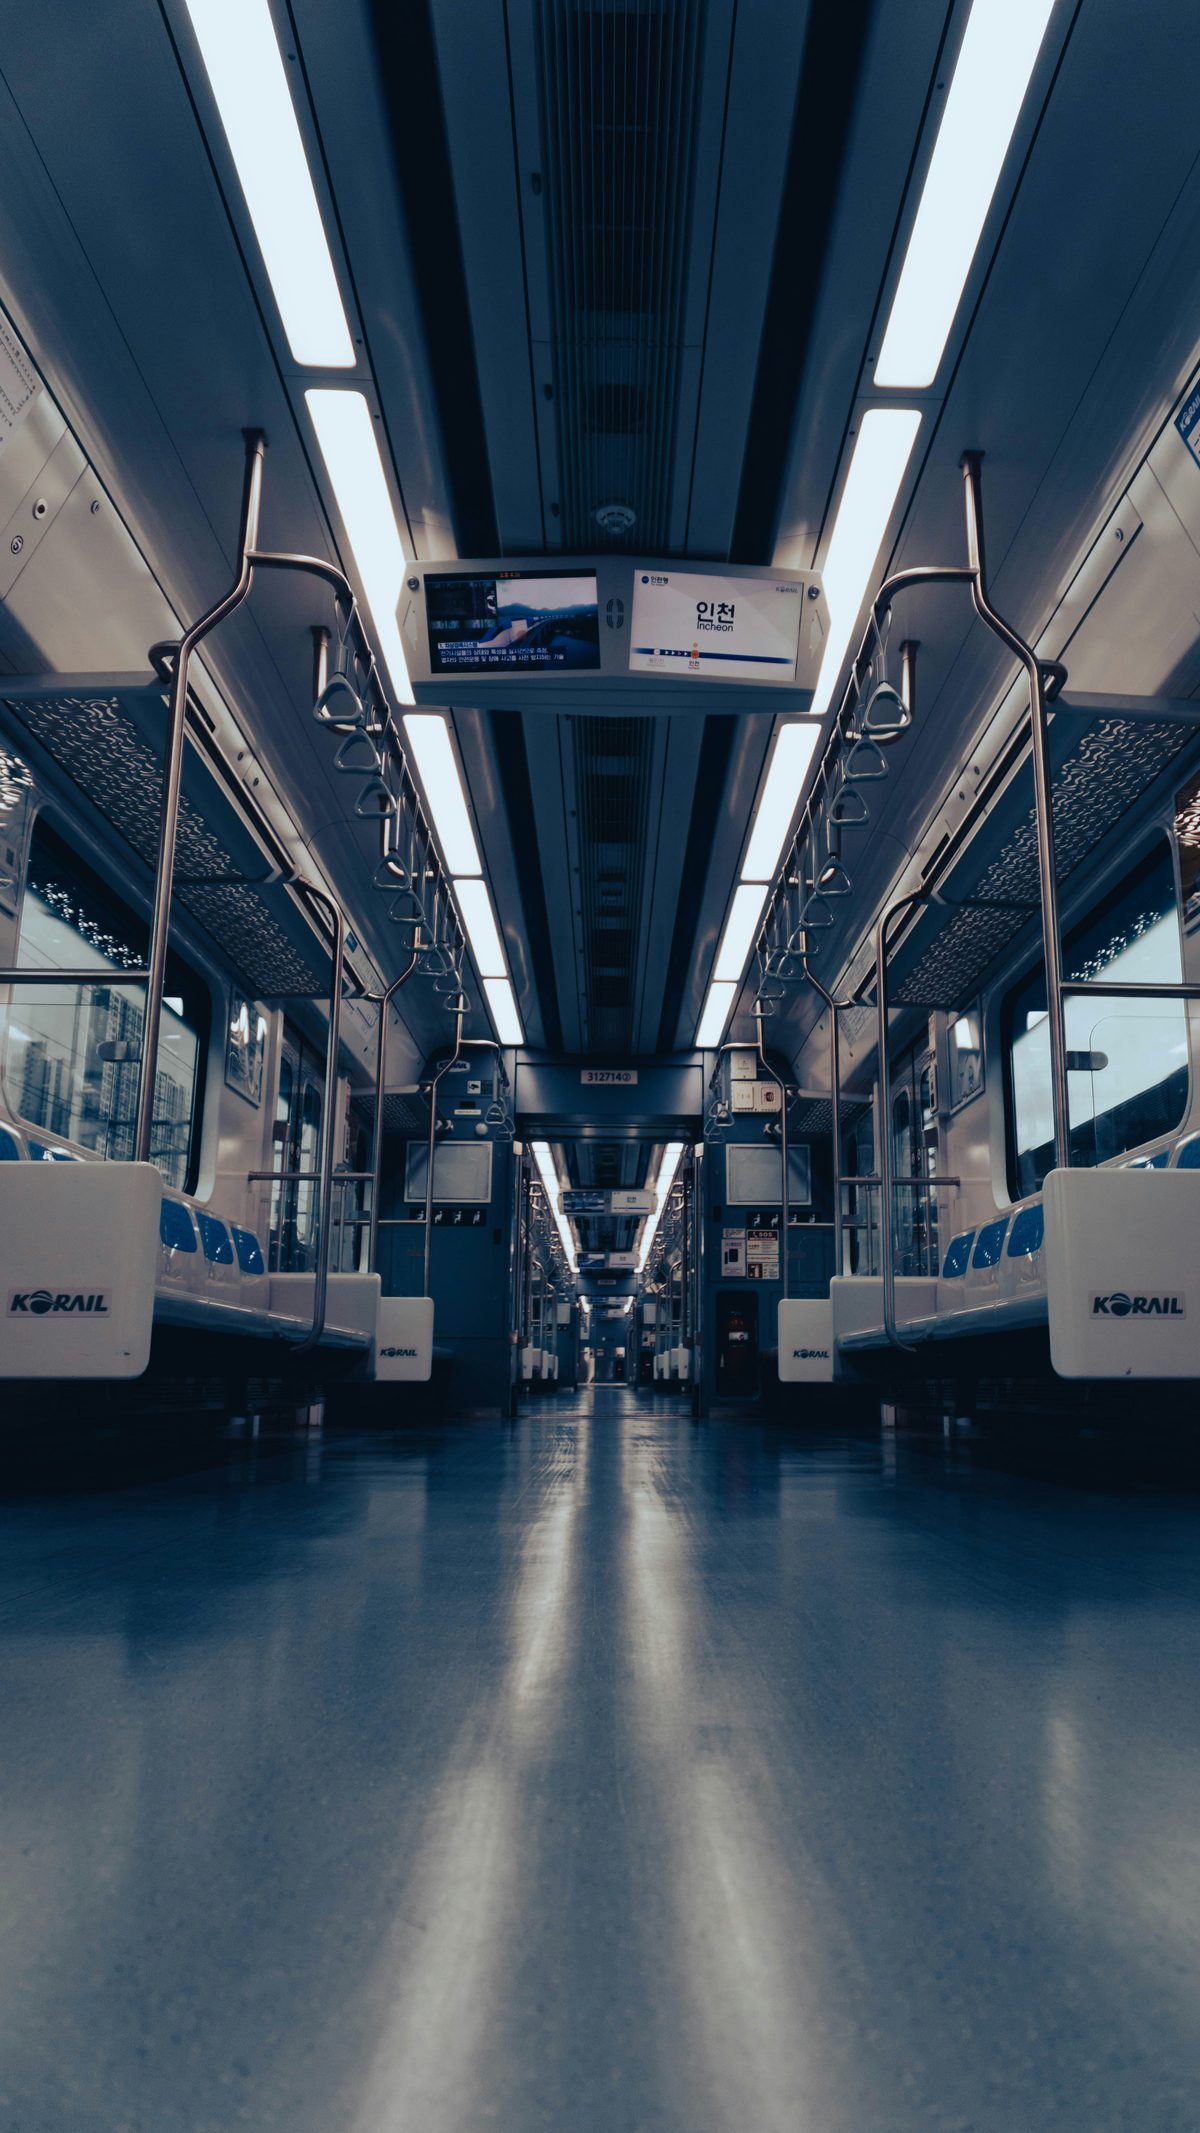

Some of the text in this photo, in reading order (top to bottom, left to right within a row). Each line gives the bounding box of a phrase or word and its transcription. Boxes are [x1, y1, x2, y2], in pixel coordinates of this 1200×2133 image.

[651, 576, 669, 584] 인천행
[696, 601, 735, 624] 인천
[696, 621, 734, 632] Incheon
[10, 1290, 108, 1315] KORAIL
[1092, 1292, 1184, 1316] KORAIL
[380, 1347, 418, 1357] KORAIL
[792, 1348, 830, 1359] KORAIL
